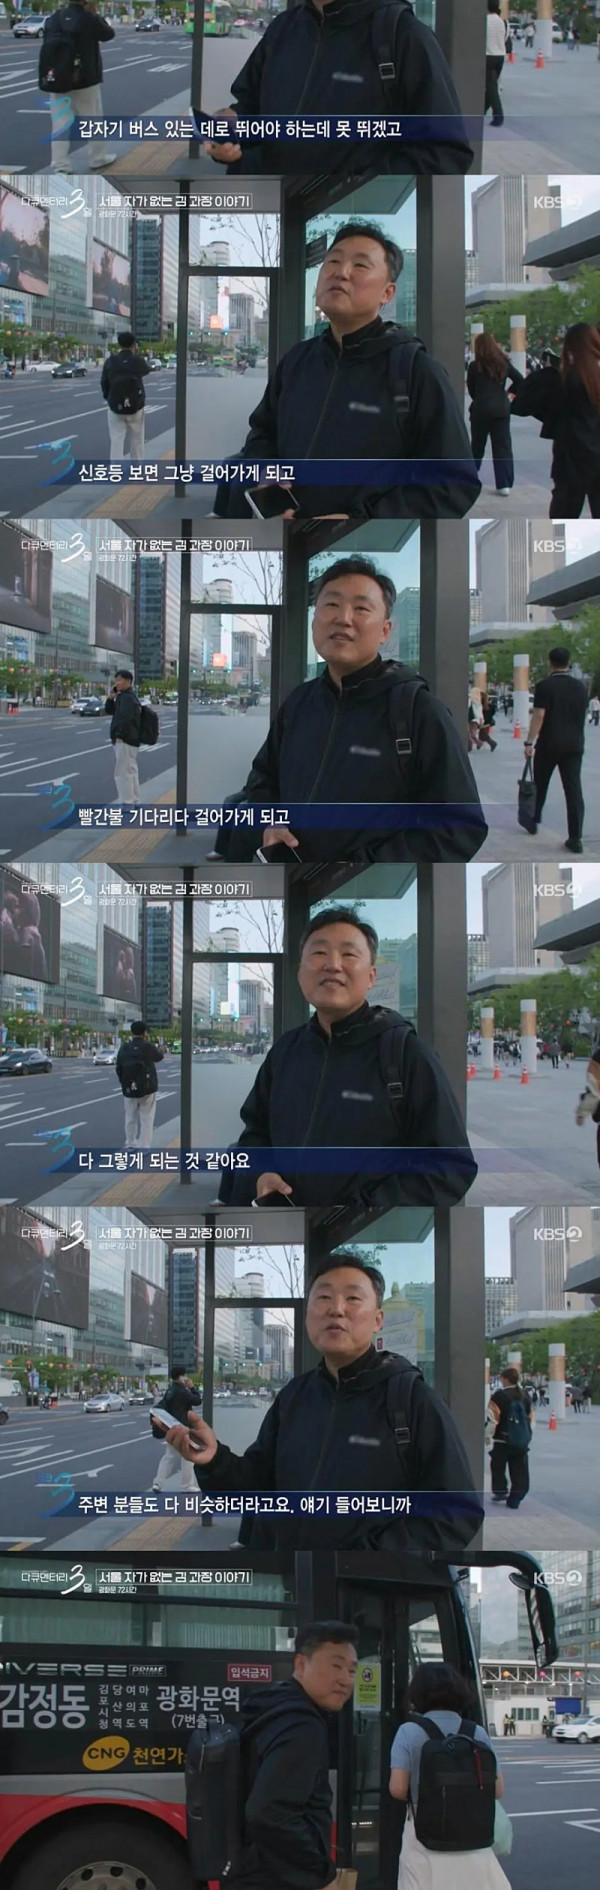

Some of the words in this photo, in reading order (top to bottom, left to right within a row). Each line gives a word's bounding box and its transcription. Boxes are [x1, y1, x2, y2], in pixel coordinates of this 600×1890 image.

[0, 1662, 127, 1677] IVERSE
[132, 1665, 164, 1675] PRIME
[230, 1666, 270, 1679] 입석금지
[0, 1683, 90, 1729] 감정동
[156, 1685, 240, 1712] 광화문역
[88, 1748, 126, 1759] CNG
[133, 1747, 188, 1766] 천연가
